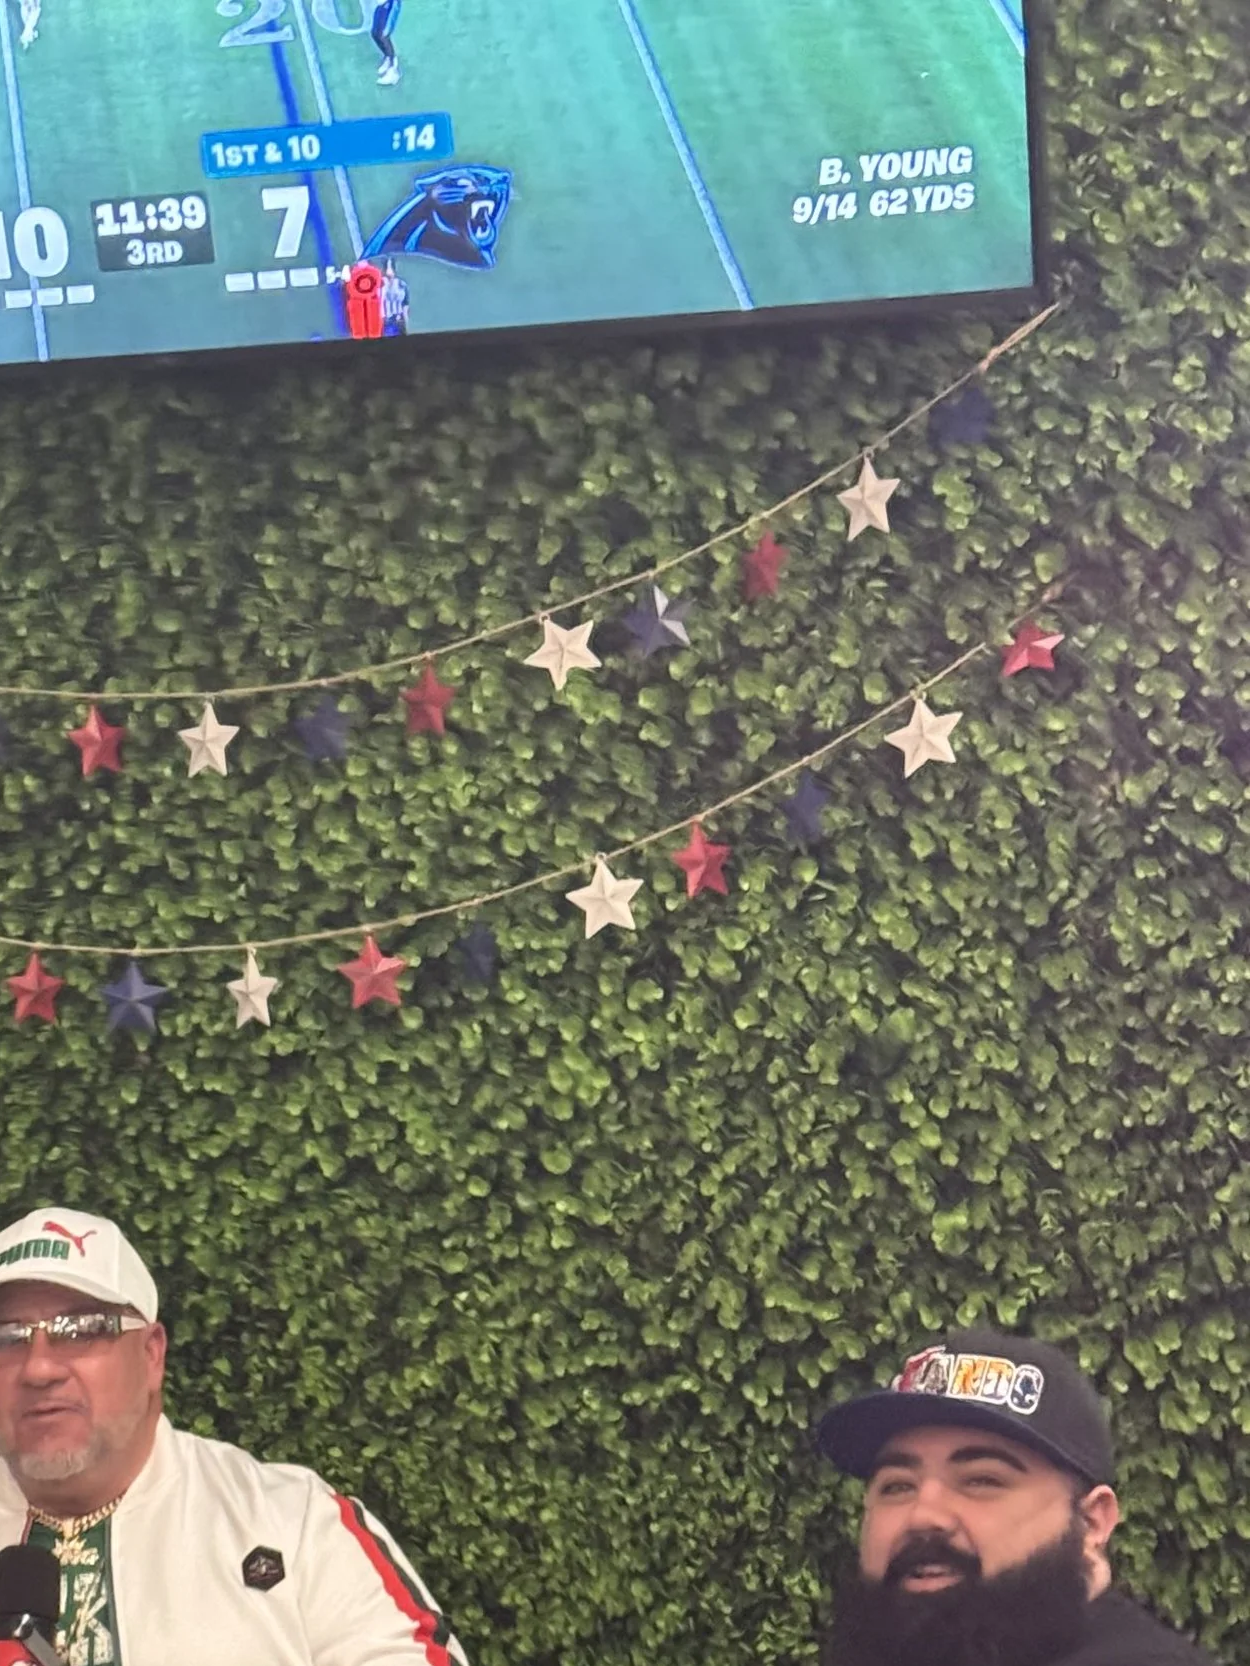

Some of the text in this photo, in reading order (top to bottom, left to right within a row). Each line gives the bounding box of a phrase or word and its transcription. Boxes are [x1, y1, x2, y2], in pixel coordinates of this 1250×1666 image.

[211, 142, 259, 168] 1ST
[263, 142, 283, 164] &
[287, 134, 321, 161] 10
[819, 146, 973, 186] B. YOUNG
[93, 195, 207, 238] 11:39
[261, 186, 310, 258] 7
[792, 182, 975, 225] 9/14 62 YDS
[126, 238, 184, 267] 3RD
